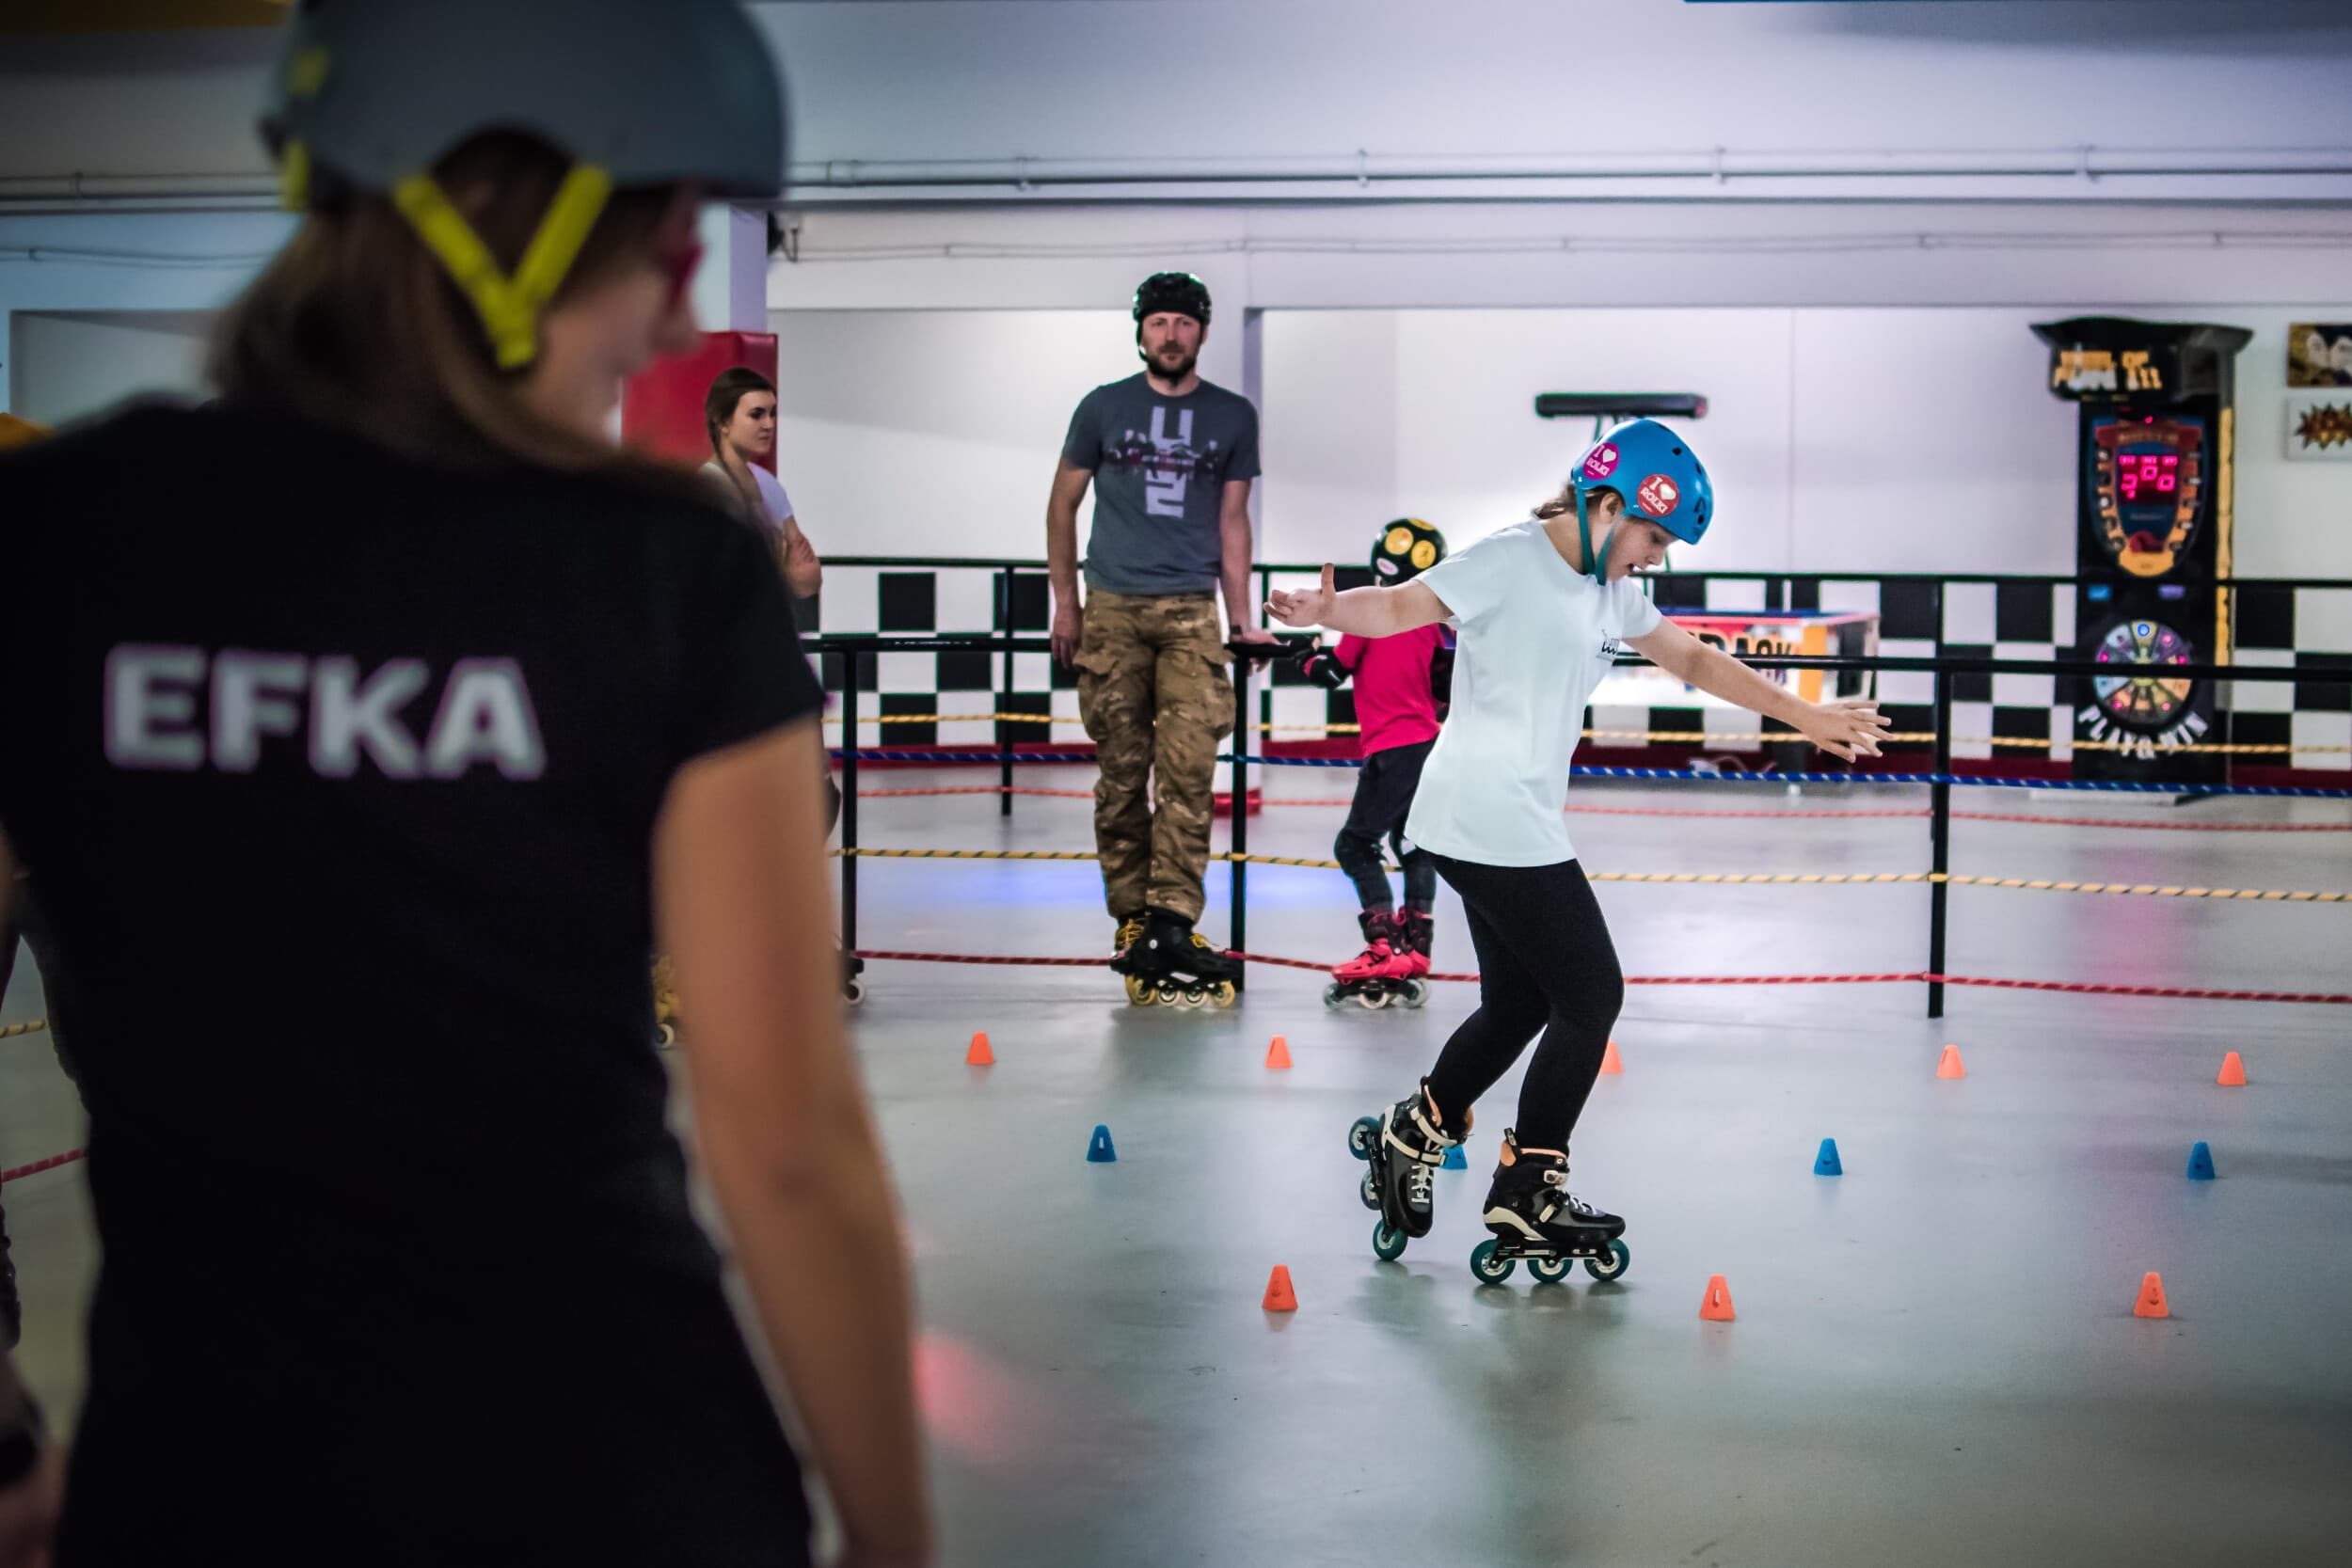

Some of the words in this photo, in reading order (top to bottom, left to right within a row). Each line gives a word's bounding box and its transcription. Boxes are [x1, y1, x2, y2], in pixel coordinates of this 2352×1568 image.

[1649, 477, 1663, 491] I
[1641, 487, 1669, 515] ROLKI
[103, 643, 546, 782] EFKA
